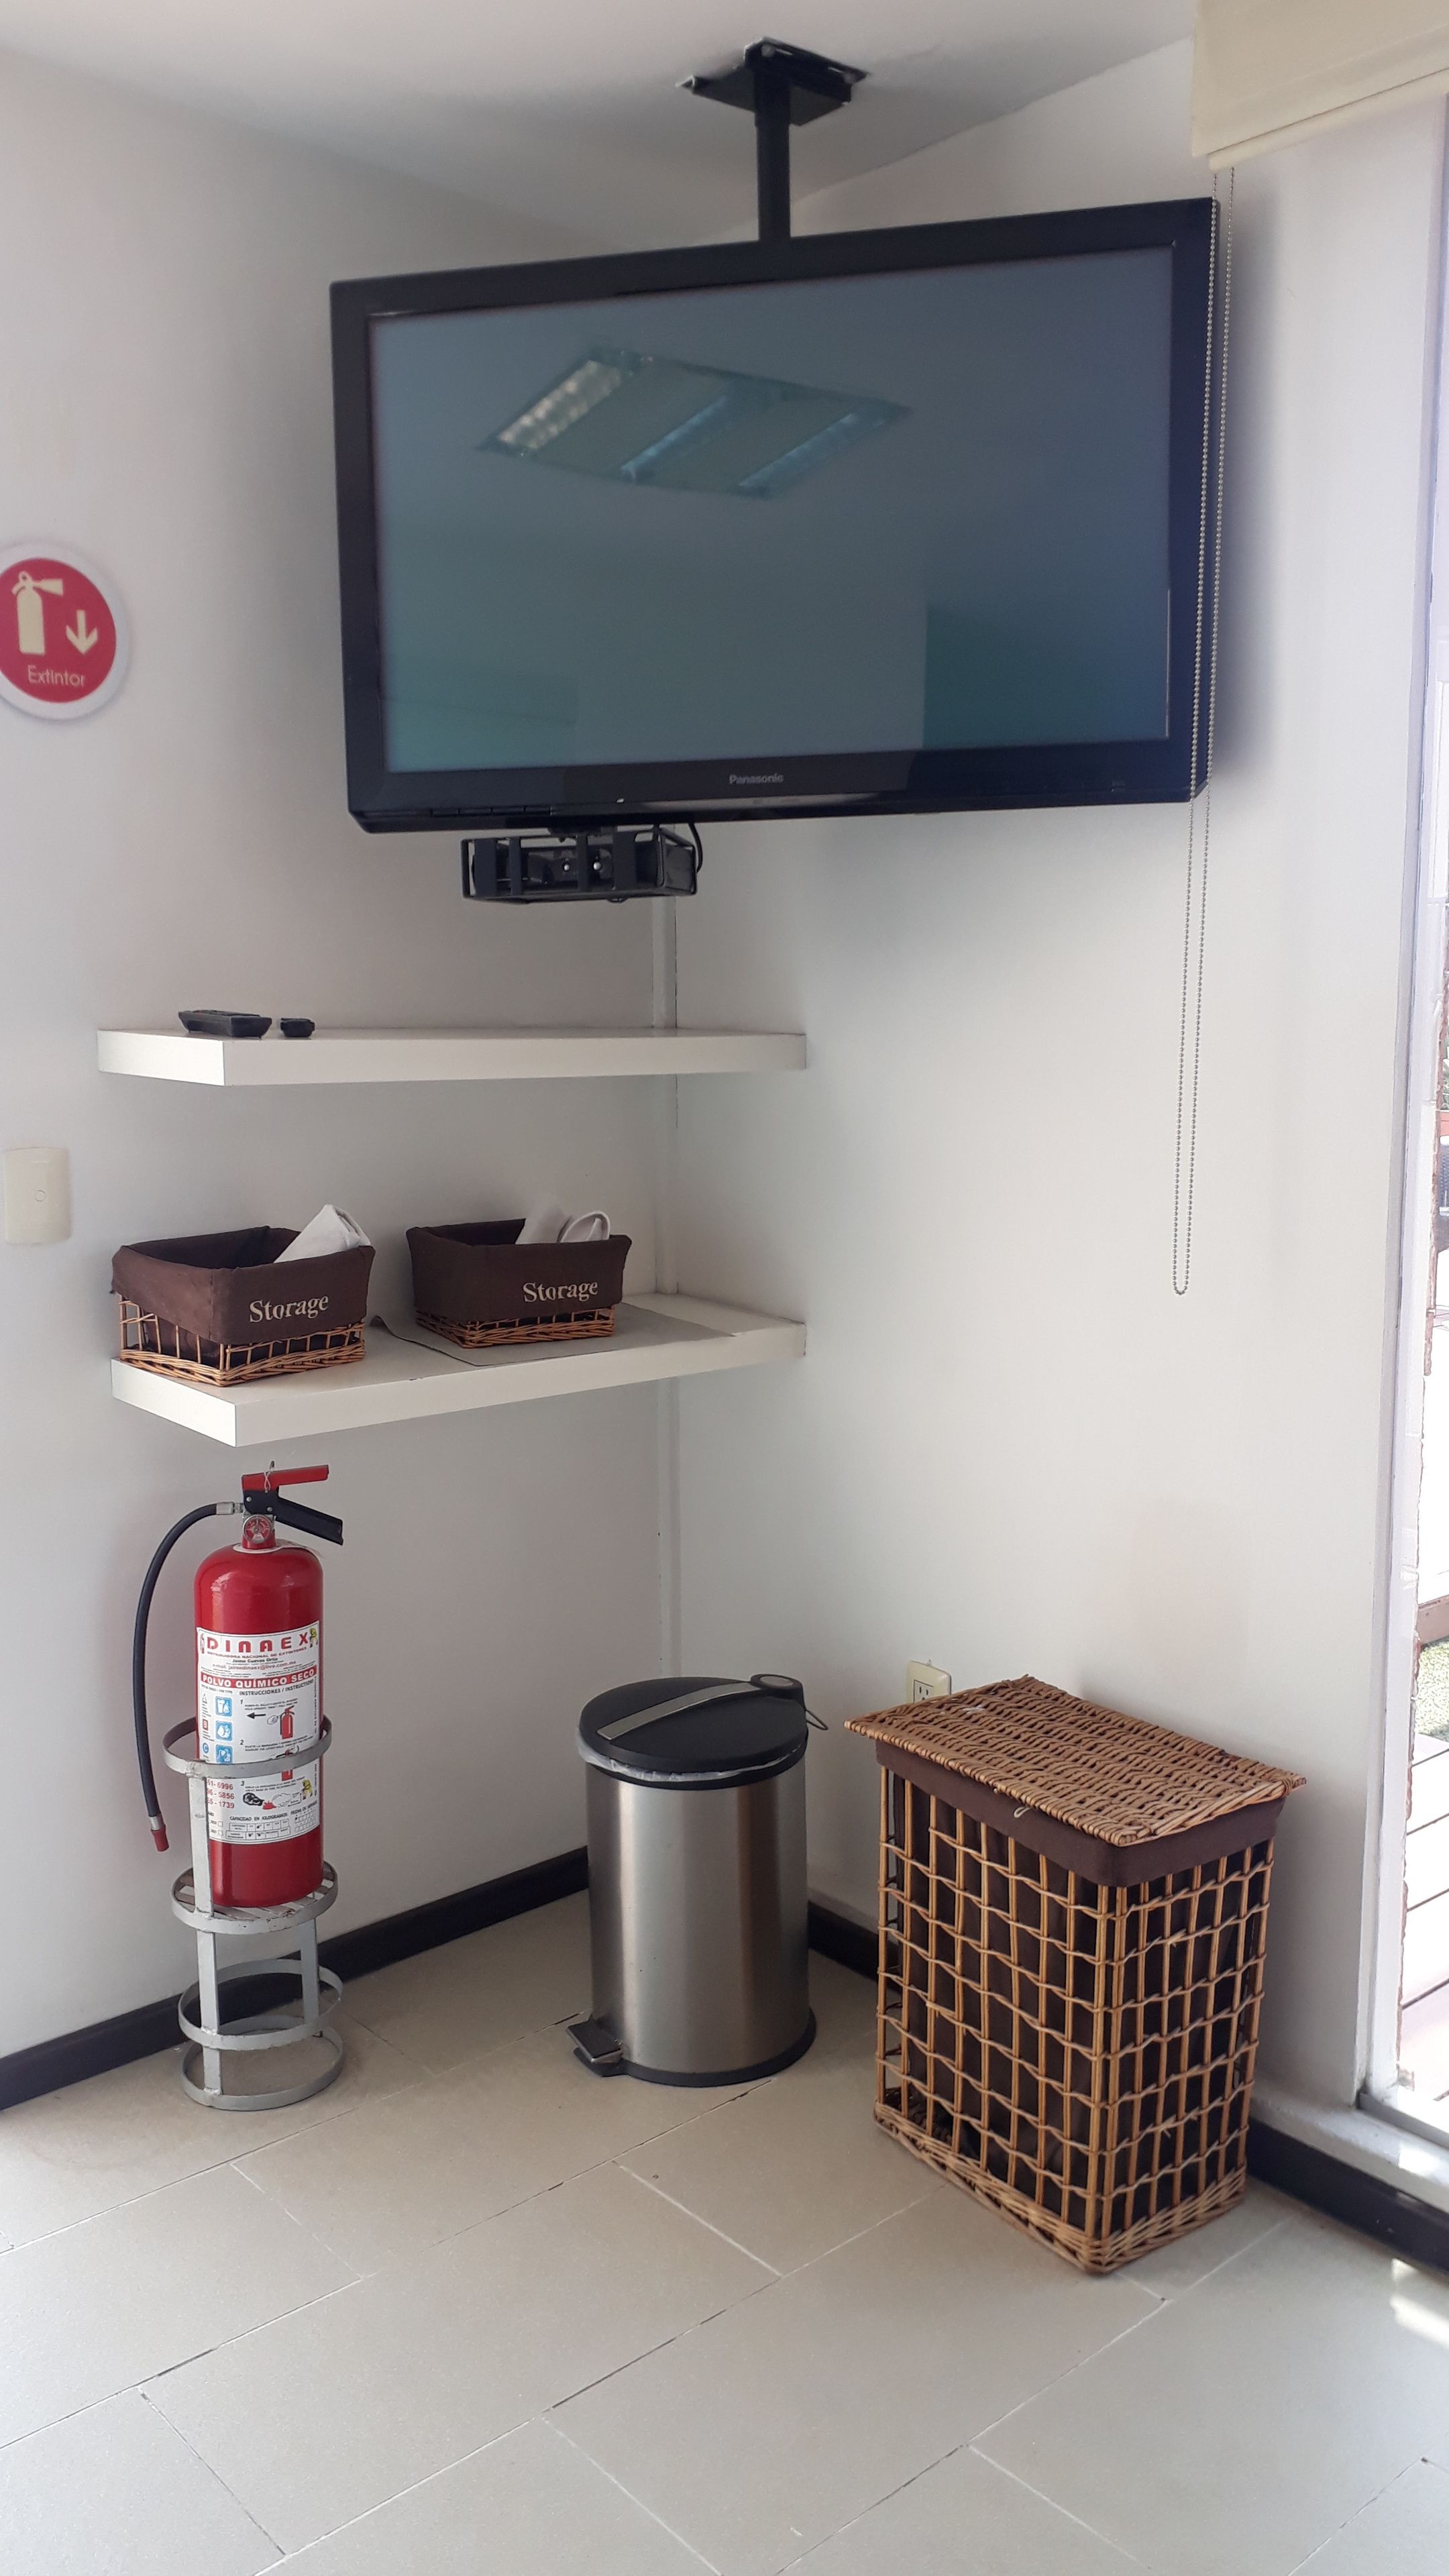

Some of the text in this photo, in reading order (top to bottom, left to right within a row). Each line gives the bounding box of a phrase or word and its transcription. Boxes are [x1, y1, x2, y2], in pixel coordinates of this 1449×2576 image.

[28, 664, 85, 688] Extintor
[729, 773, 784, 784] Panasonic
[523, 1282, 598, 1302] Storage
[249, 1295, 329, 1323] Storage
[203, 1674, 231, 1686] POLVO
[235, 1677, 287, 1688] QUÍMICO
[291, 1668, 314, 1682] SECO
[239, 1688, 281, 1696] INSTRUCCIONES
